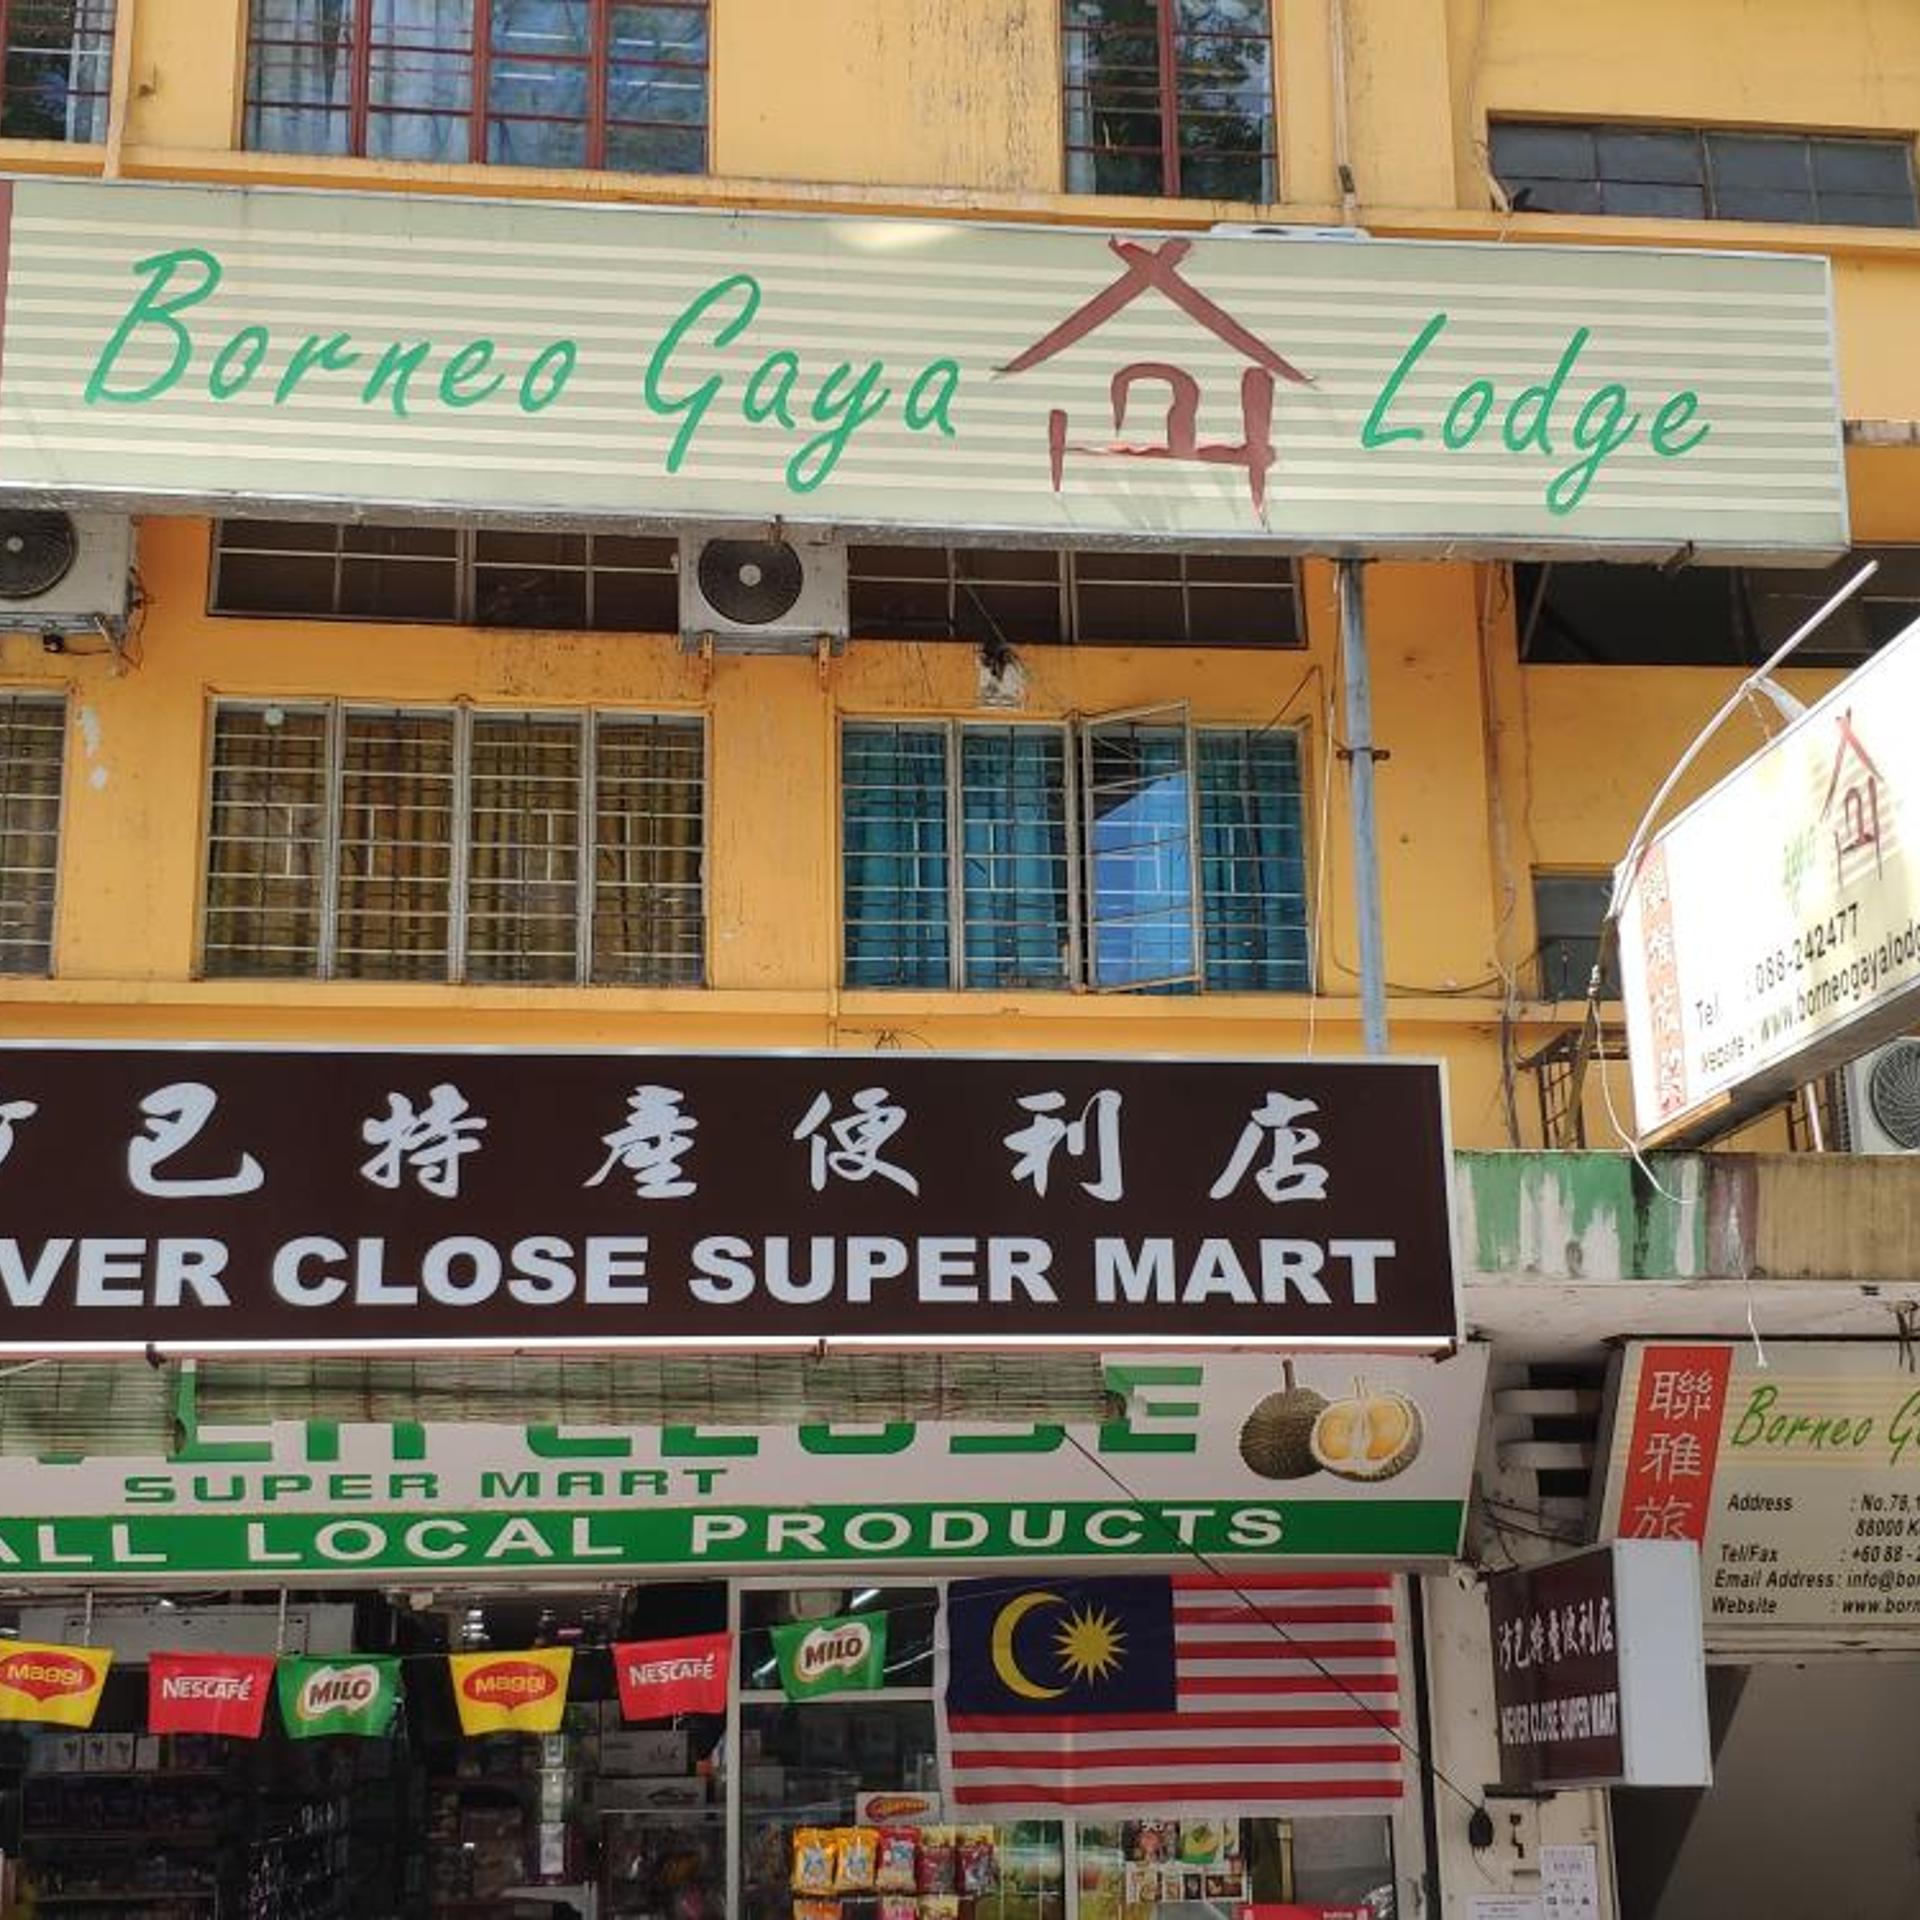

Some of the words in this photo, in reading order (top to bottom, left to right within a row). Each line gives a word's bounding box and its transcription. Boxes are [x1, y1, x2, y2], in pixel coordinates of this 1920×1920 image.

[85, 248, 577, 416] Borneo
[645, 274, 959, 493] Gaya
[1362, 313, 1710, 515] Lodge
[0, 1237, 232, 1307] VER
[271, 1236, 650, 1306] CLOSE
[688, 1236, 1059, 1304] SUPER
[1095, 1238, 1397, 1304] MART
[1732, 1384, 1873, 1447] Borneo
[125, 1472, 439, 1503] SUPER
[481, 1469, 728, 1498] MART
[1727, 1493, 1794, 1512] Address
[246, 1516, 625, 1562] LOCAL
[691, 1507, 1285, 1555] PRODUCTS
[1714, 1569, 1761, 1588] Email
[1711, 1597, 1778, 1614] Website
[803, 1635, 864, 1668] MILO
[6, 1662, 86, 1687] Maggi
[474, 1673, 547, 1696] Maggi
[308, 1678, 374, 1707] MILO
